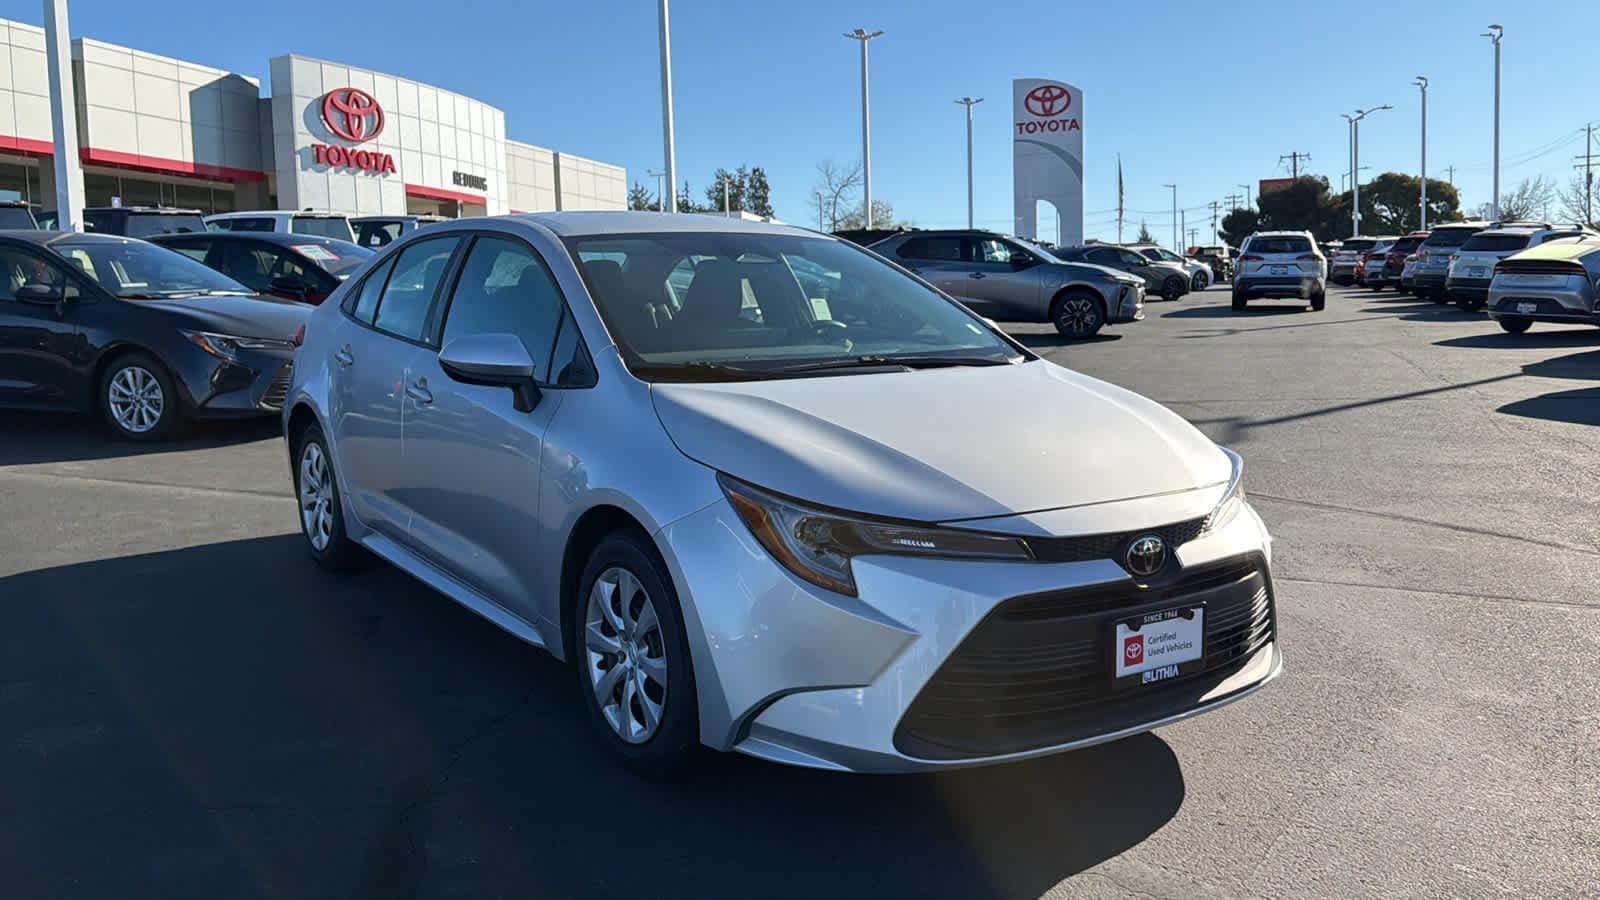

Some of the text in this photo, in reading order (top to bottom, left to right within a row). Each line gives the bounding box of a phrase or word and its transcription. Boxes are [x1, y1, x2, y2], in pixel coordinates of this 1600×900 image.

[1015, 118, 1080, 135] TOYOTA
[311, 143, 397, 174] TOYOTA
[1147, 631, 1177, 645] Certified
[1147, 639, 1193, 657] Used Vehicles
[1150, 664, 1180, 682] LITHIA
